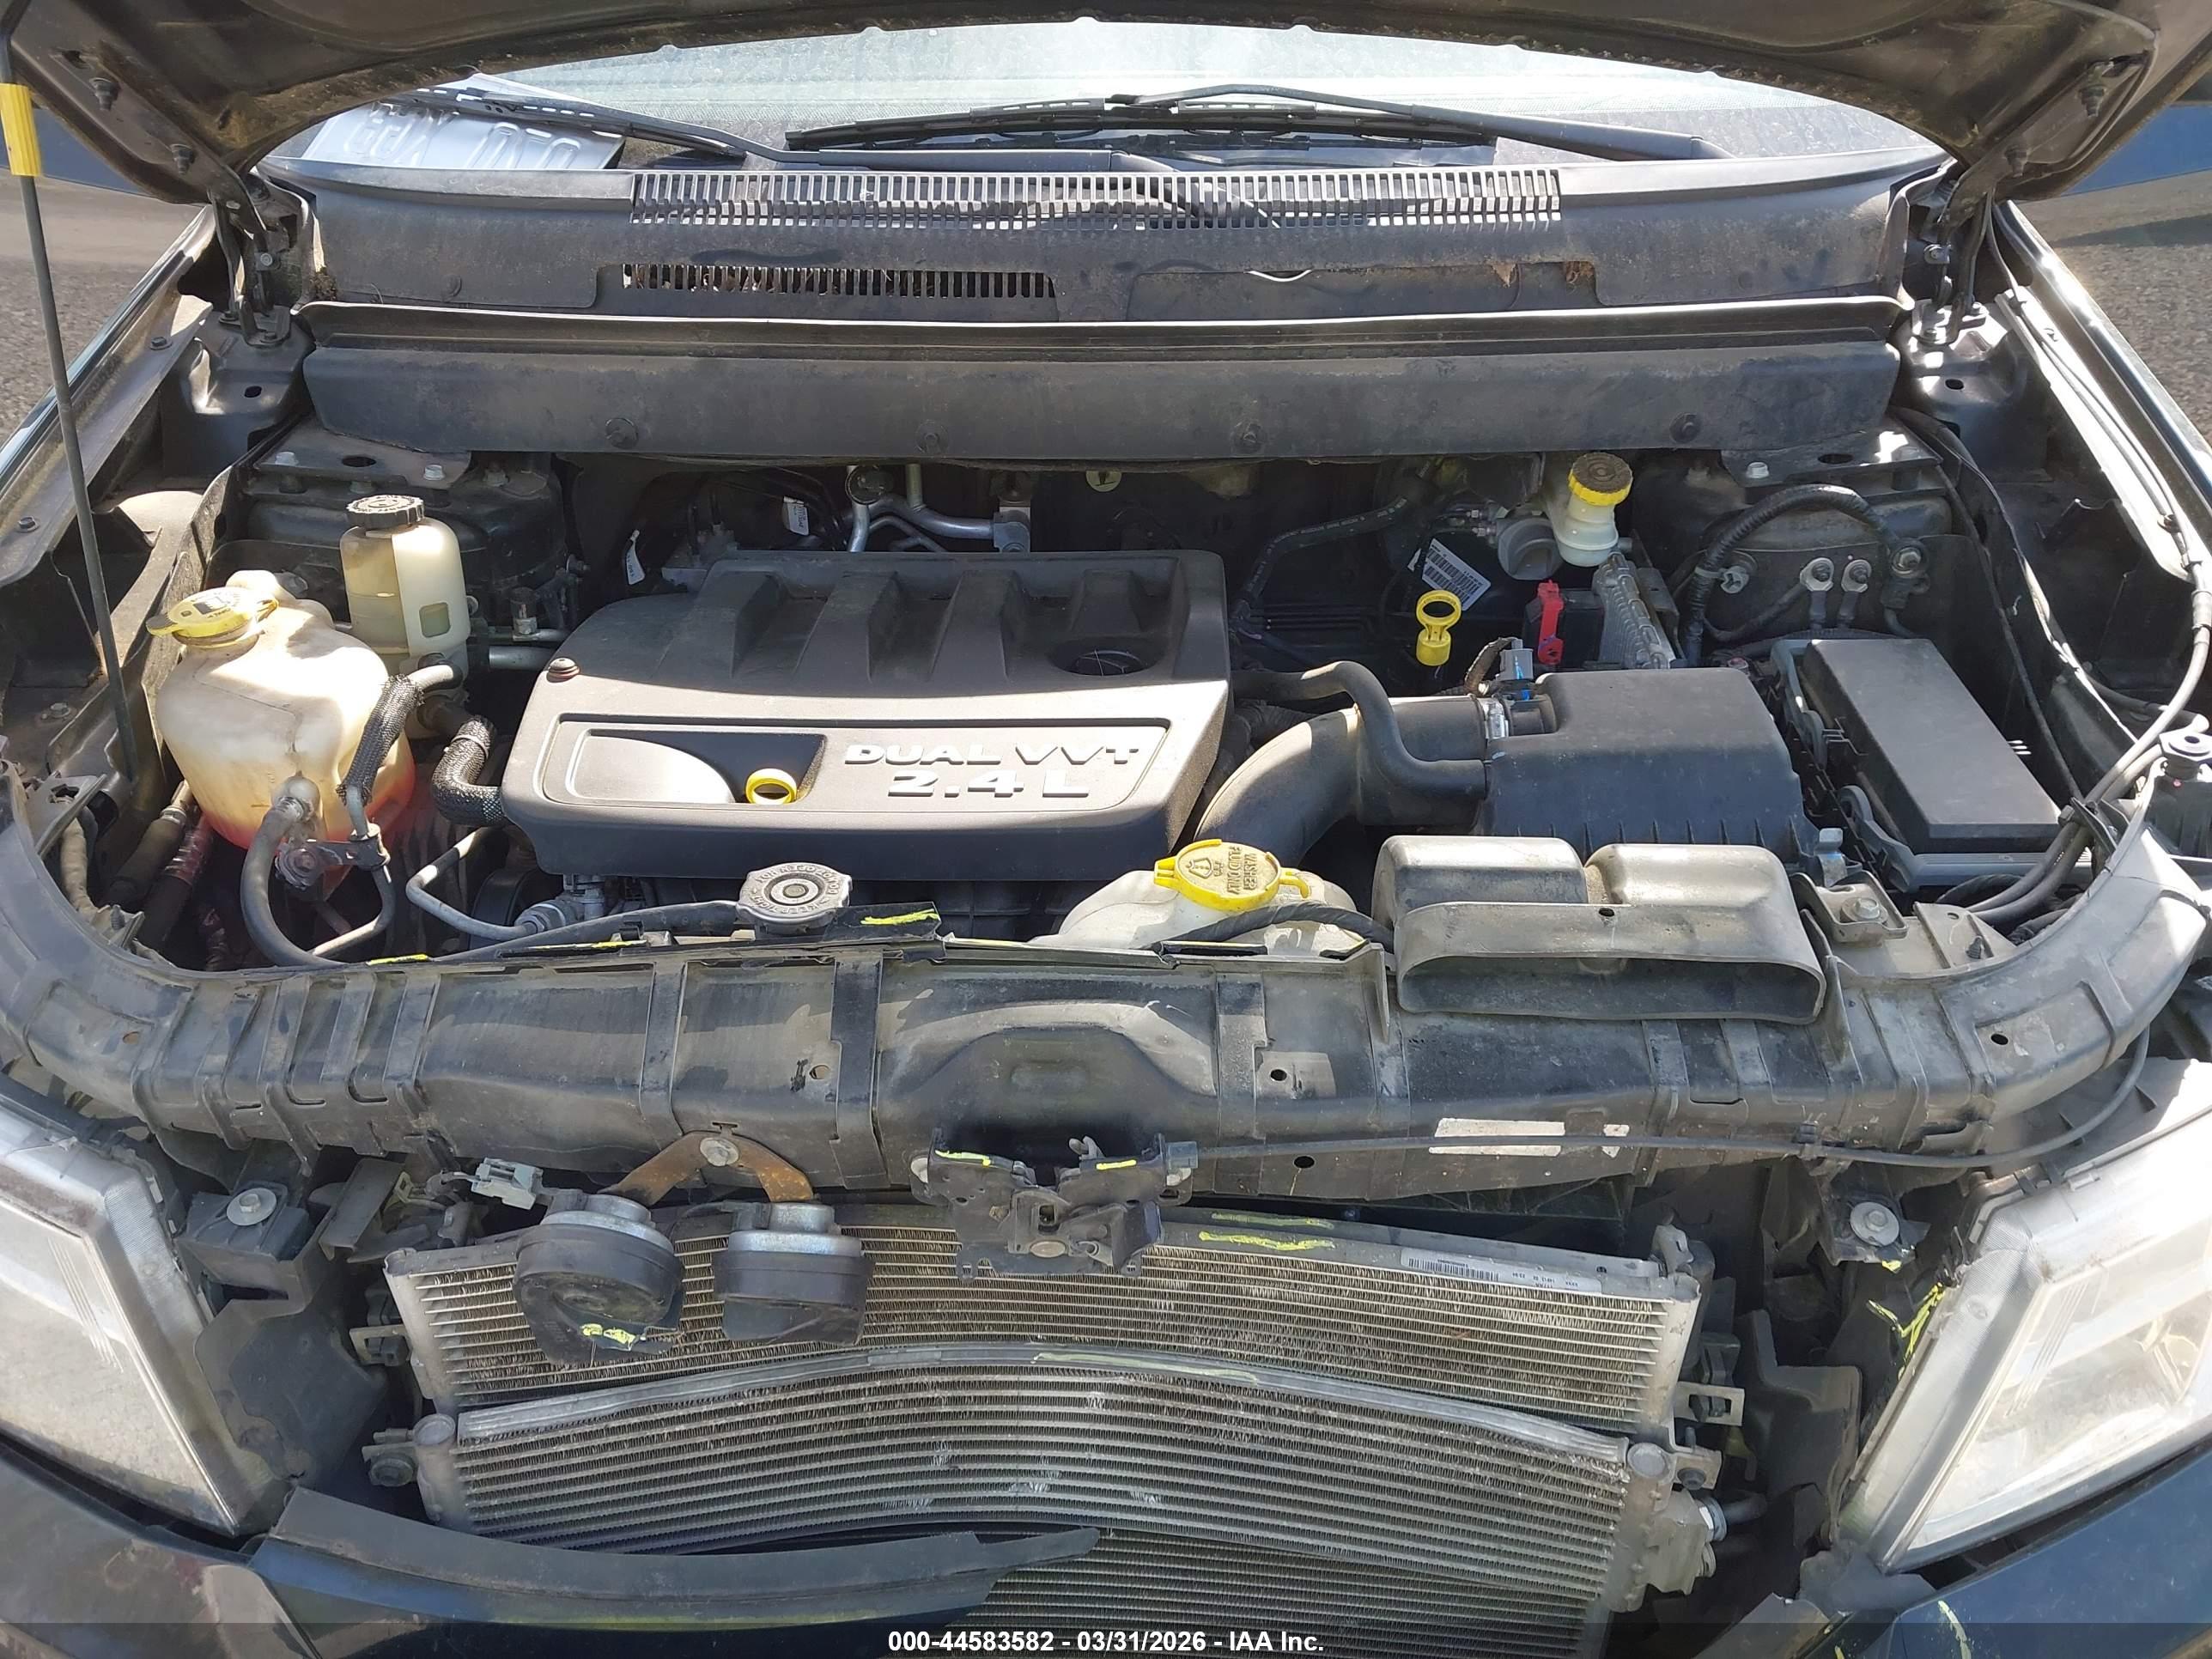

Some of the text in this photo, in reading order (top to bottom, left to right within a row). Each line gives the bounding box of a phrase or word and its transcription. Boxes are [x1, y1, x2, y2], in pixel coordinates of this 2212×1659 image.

[843, 743, 1139, 766] DUAL VVT
[887, 769, 1090, 799] 2.4 L
[756, 865, 840, 895] DO NOT OPEN HOT
[1227, 846, 1241, 895] FLUID ONLY
[1243, 853, 1257, 890] WASHER
[750, 895, 819, 915] KEEP TIGHT
